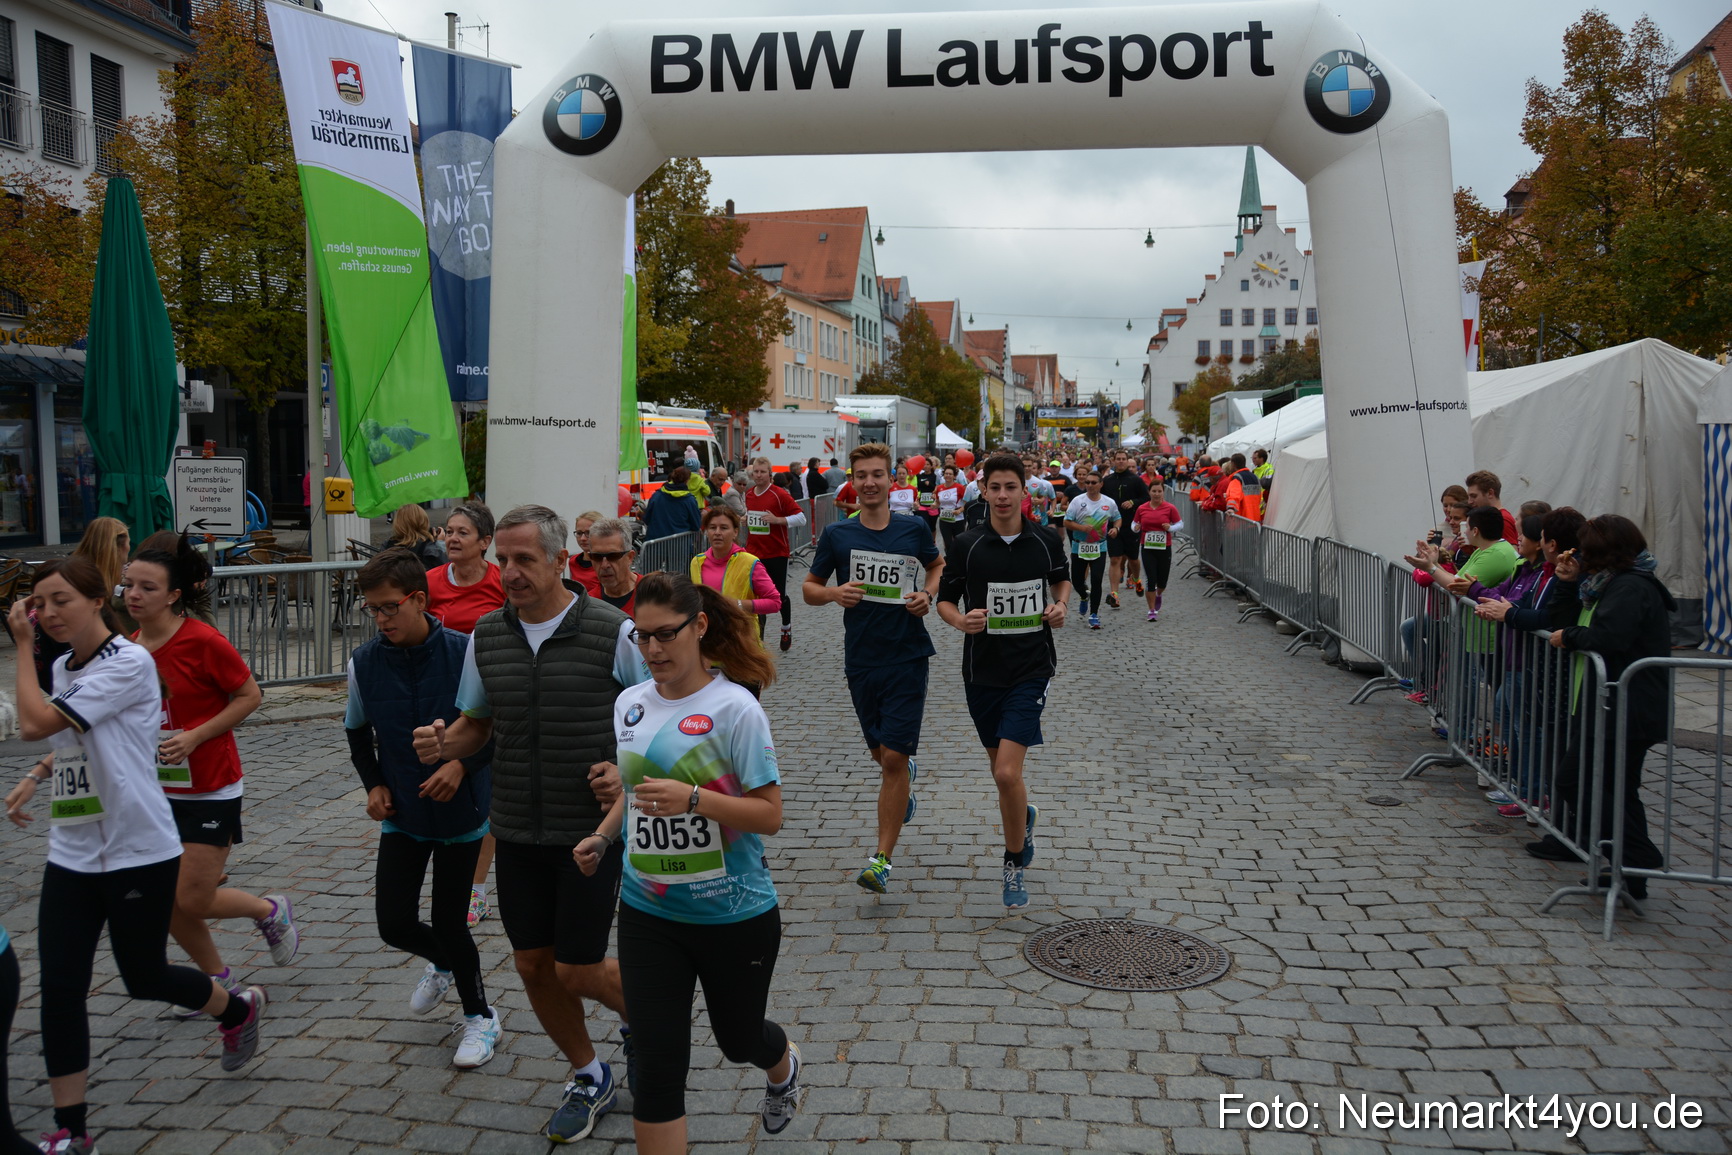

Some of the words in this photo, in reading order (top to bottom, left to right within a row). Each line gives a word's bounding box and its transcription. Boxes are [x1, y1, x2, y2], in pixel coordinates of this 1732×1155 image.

[650, 29, 864, 94] BMW
[886, 20, 1275, 98] Laufsport
[1312, 51, 1381, 79] BMW
[553, 75, 616, 103] BMW
[436, 161, 488, 193] THE
[428, 195, 470, 227] WAY
[459, 223, 491, 255] GO
[1349, 400, 1468, 417] www.bmw-laufsport.de
[177, 466, 212, 475] Fußgänger
[213, 466, 242, 475] Richtung
[189, 476, 231, 484] Lammsbräu-
[186, 486, 217, 494] Kreuzung
[190, 505, 232, 513] Kaserngasse
[1147, 534, 1165, 542] 5152
[1081, 545, 1099, 553] 5004
[856, 563, 900, 585] 5165
[866, 587, 886, 596] Jonas
[1009, 586, 1034, 594] Neumarkt
[993, 593, 1037, 615] 5171
[1000, 619, 1034, 627] Christian
[636, 815, 711, 850] 5053
[660, 858, 687, 872] Lisa
[689, 874, 739, 891] Neumarkter
[692, 884, 733, 900] Stadtlauf
